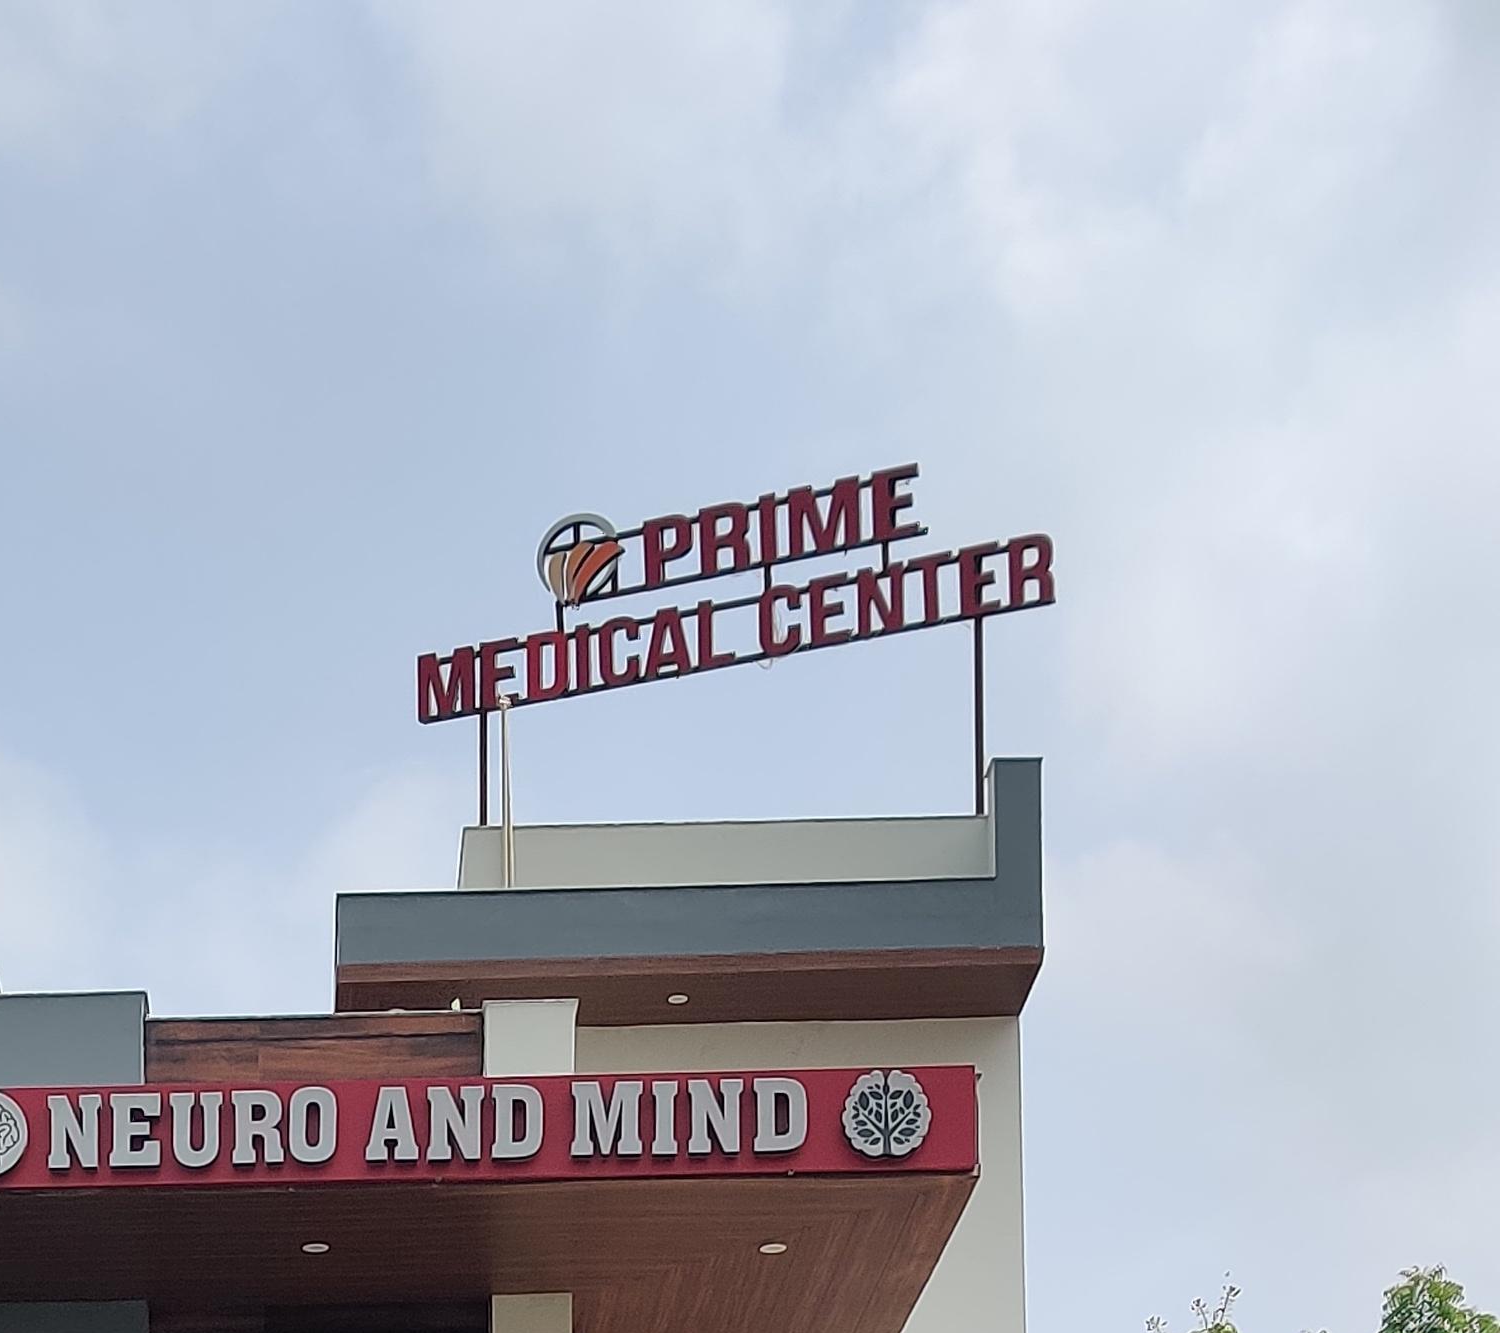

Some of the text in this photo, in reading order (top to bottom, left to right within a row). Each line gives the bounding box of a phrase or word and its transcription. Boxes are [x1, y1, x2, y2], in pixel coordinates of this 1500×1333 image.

[642, 462, 928, 590] PRIME
[417, 533, 1056, 724] MEDICAL CENTER
[46, 1076, 808, 1169] NEURO AND MIND
